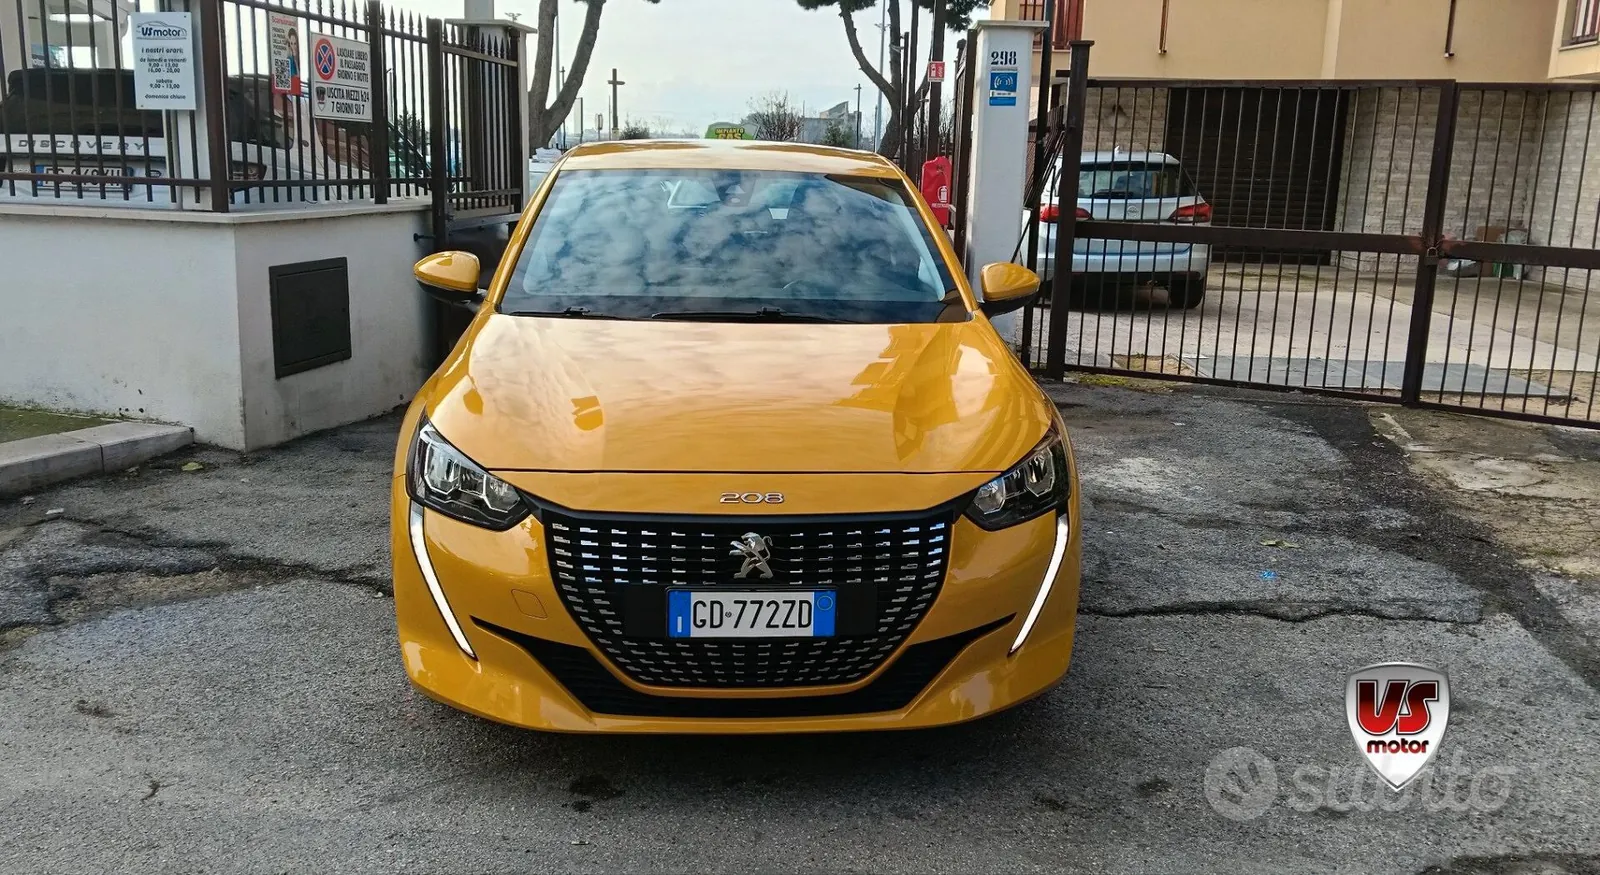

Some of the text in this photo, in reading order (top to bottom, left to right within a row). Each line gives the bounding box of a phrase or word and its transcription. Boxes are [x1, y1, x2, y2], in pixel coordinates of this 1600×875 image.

[336, 47, 368, 61] LASCIARE LIBERO
[990, 50, 1017, 66] 298
[339, 59, 365, 71] IL PASSAGGIO
[337, 69, 353, 80] GIORNO
[357, 73, 369, 82] NOTTE
[327, 87, 344, 99] USCITA
[345, 88, 360, 101] MEZZI
[331, 101, 365, 115] 7 GIORNI SU 7
[719, 492, 784, 504] 208
[692, 600, 724, 629] GD
[733, 600, 812, 629] 772ZD
